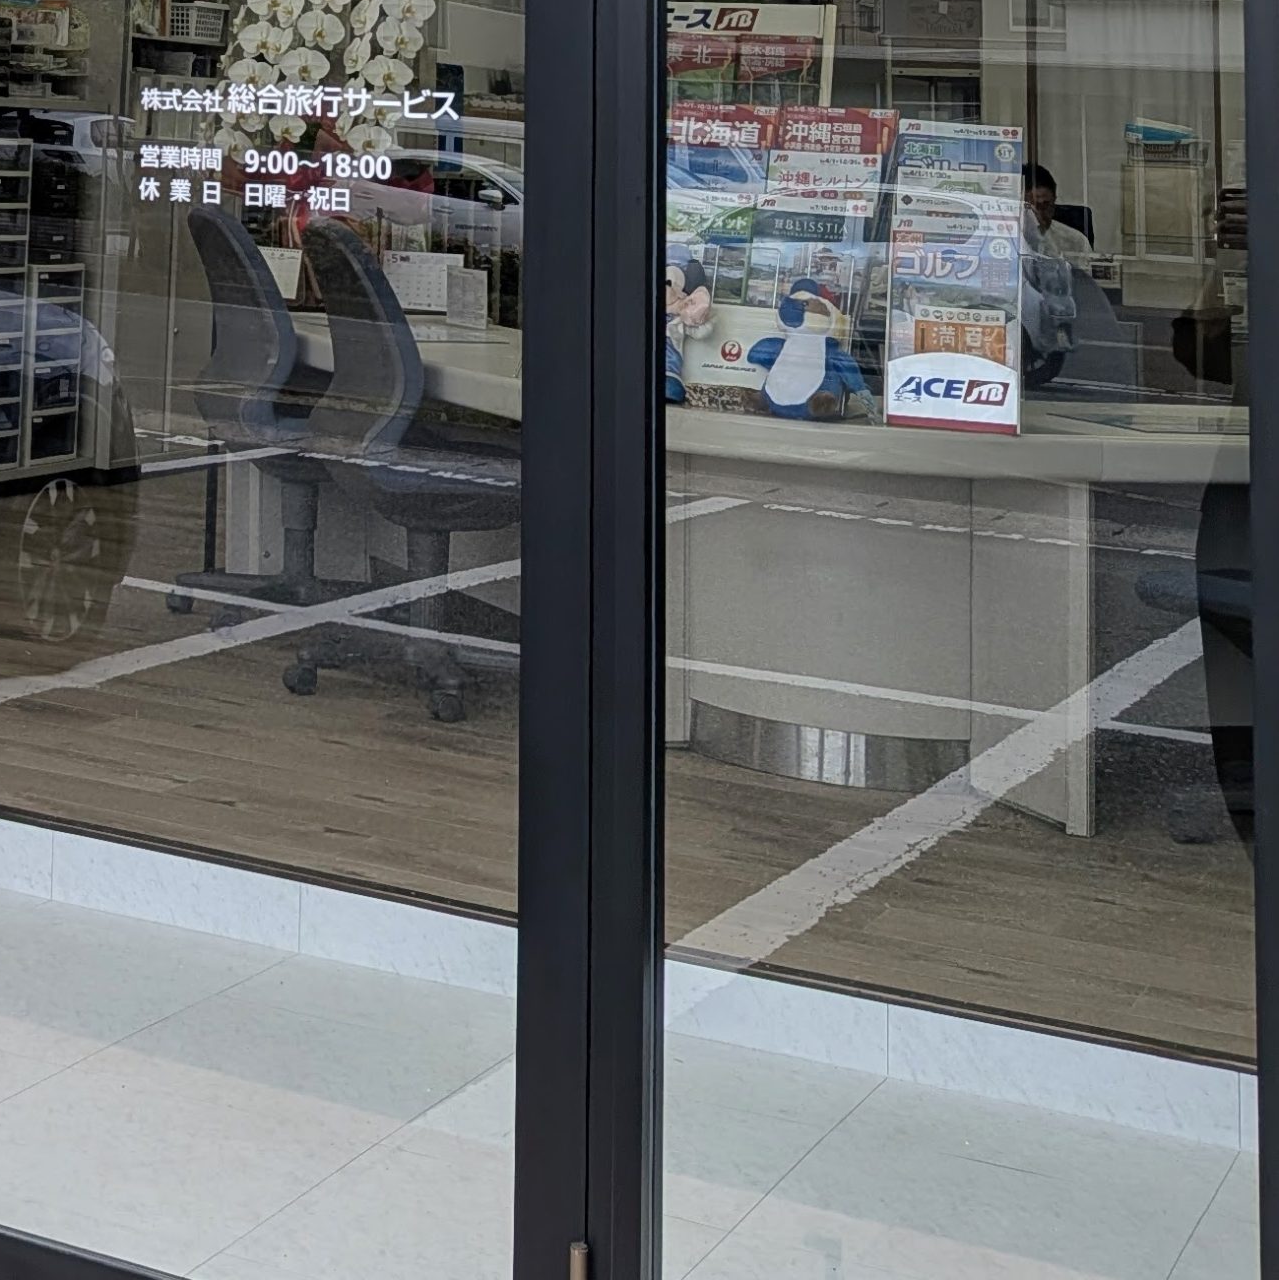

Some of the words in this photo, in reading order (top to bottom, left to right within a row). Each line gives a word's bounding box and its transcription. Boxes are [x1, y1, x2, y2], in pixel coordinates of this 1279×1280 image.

[140, 87, 224, 113] 株式会社
[227, 83, 461, 121] 総合旅行サービス
[672, 116, 762, 148] 北海道
[785, 120, 832, 143] 沖縄
[140, 144, 222, 171] 営業時間
[778, 170, 869, 188] 沖縄ヒルトン
[244, 184, 351, 213] 日曜・祝日
[895, 247, 981, 279] ゴルフ
[894, 376, 966, 400] ACE
[964, 381, 1007, 404] JTB
